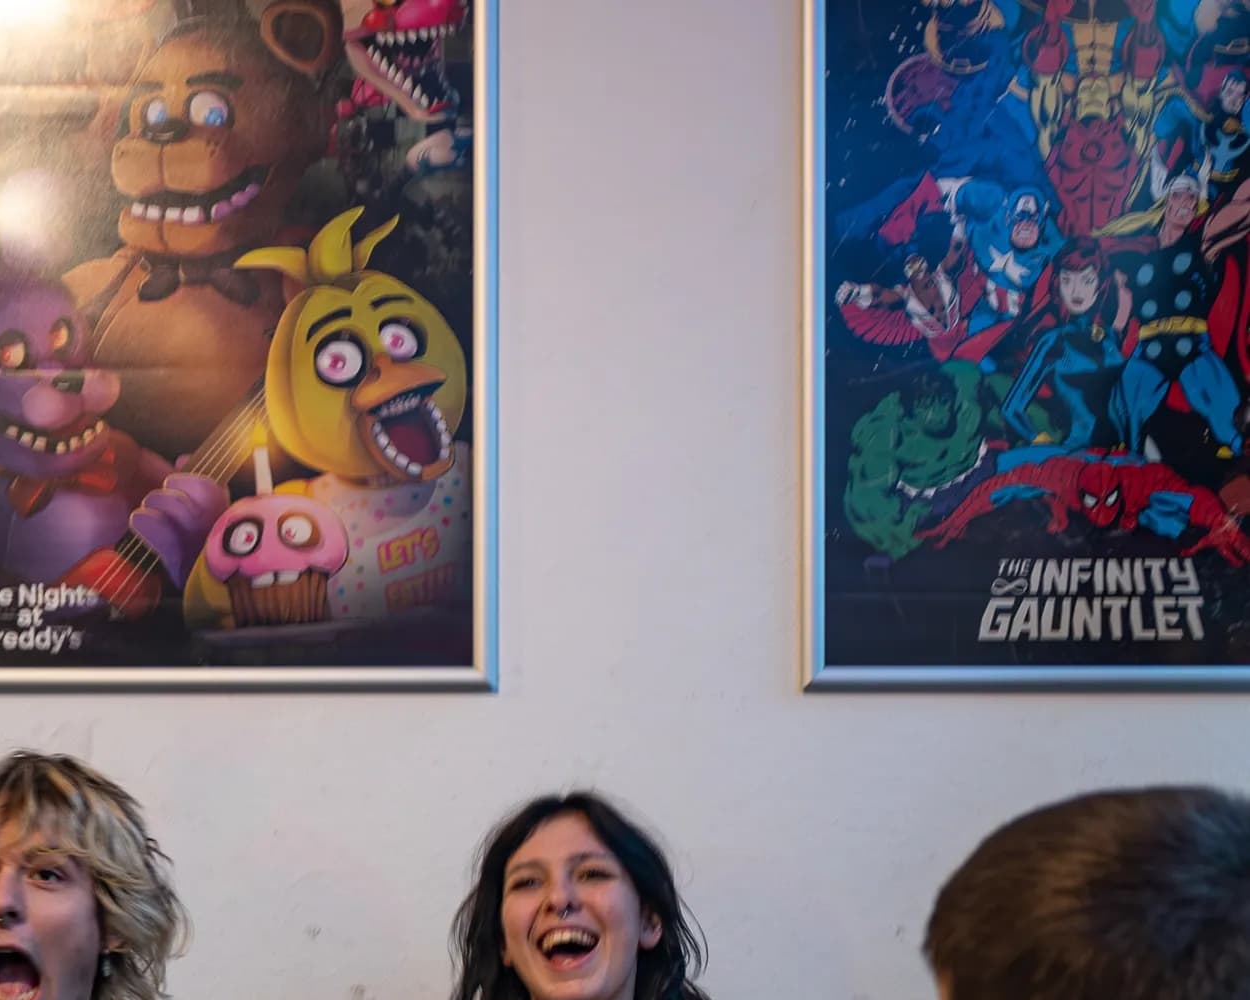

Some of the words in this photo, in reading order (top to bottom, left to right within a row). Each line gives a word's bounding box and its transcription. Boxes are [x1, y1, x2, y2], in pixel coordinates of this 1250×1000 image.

[377, 526, 440, 576] LET'S
[998, 558, 1031, 576] THE
[1028, 558, 1200, 595] INFINITY
[18, 582, 100, 611] Nights
[17, 605, 43, 627] at
[978, 597, 1204, 641] GAUNTLET
